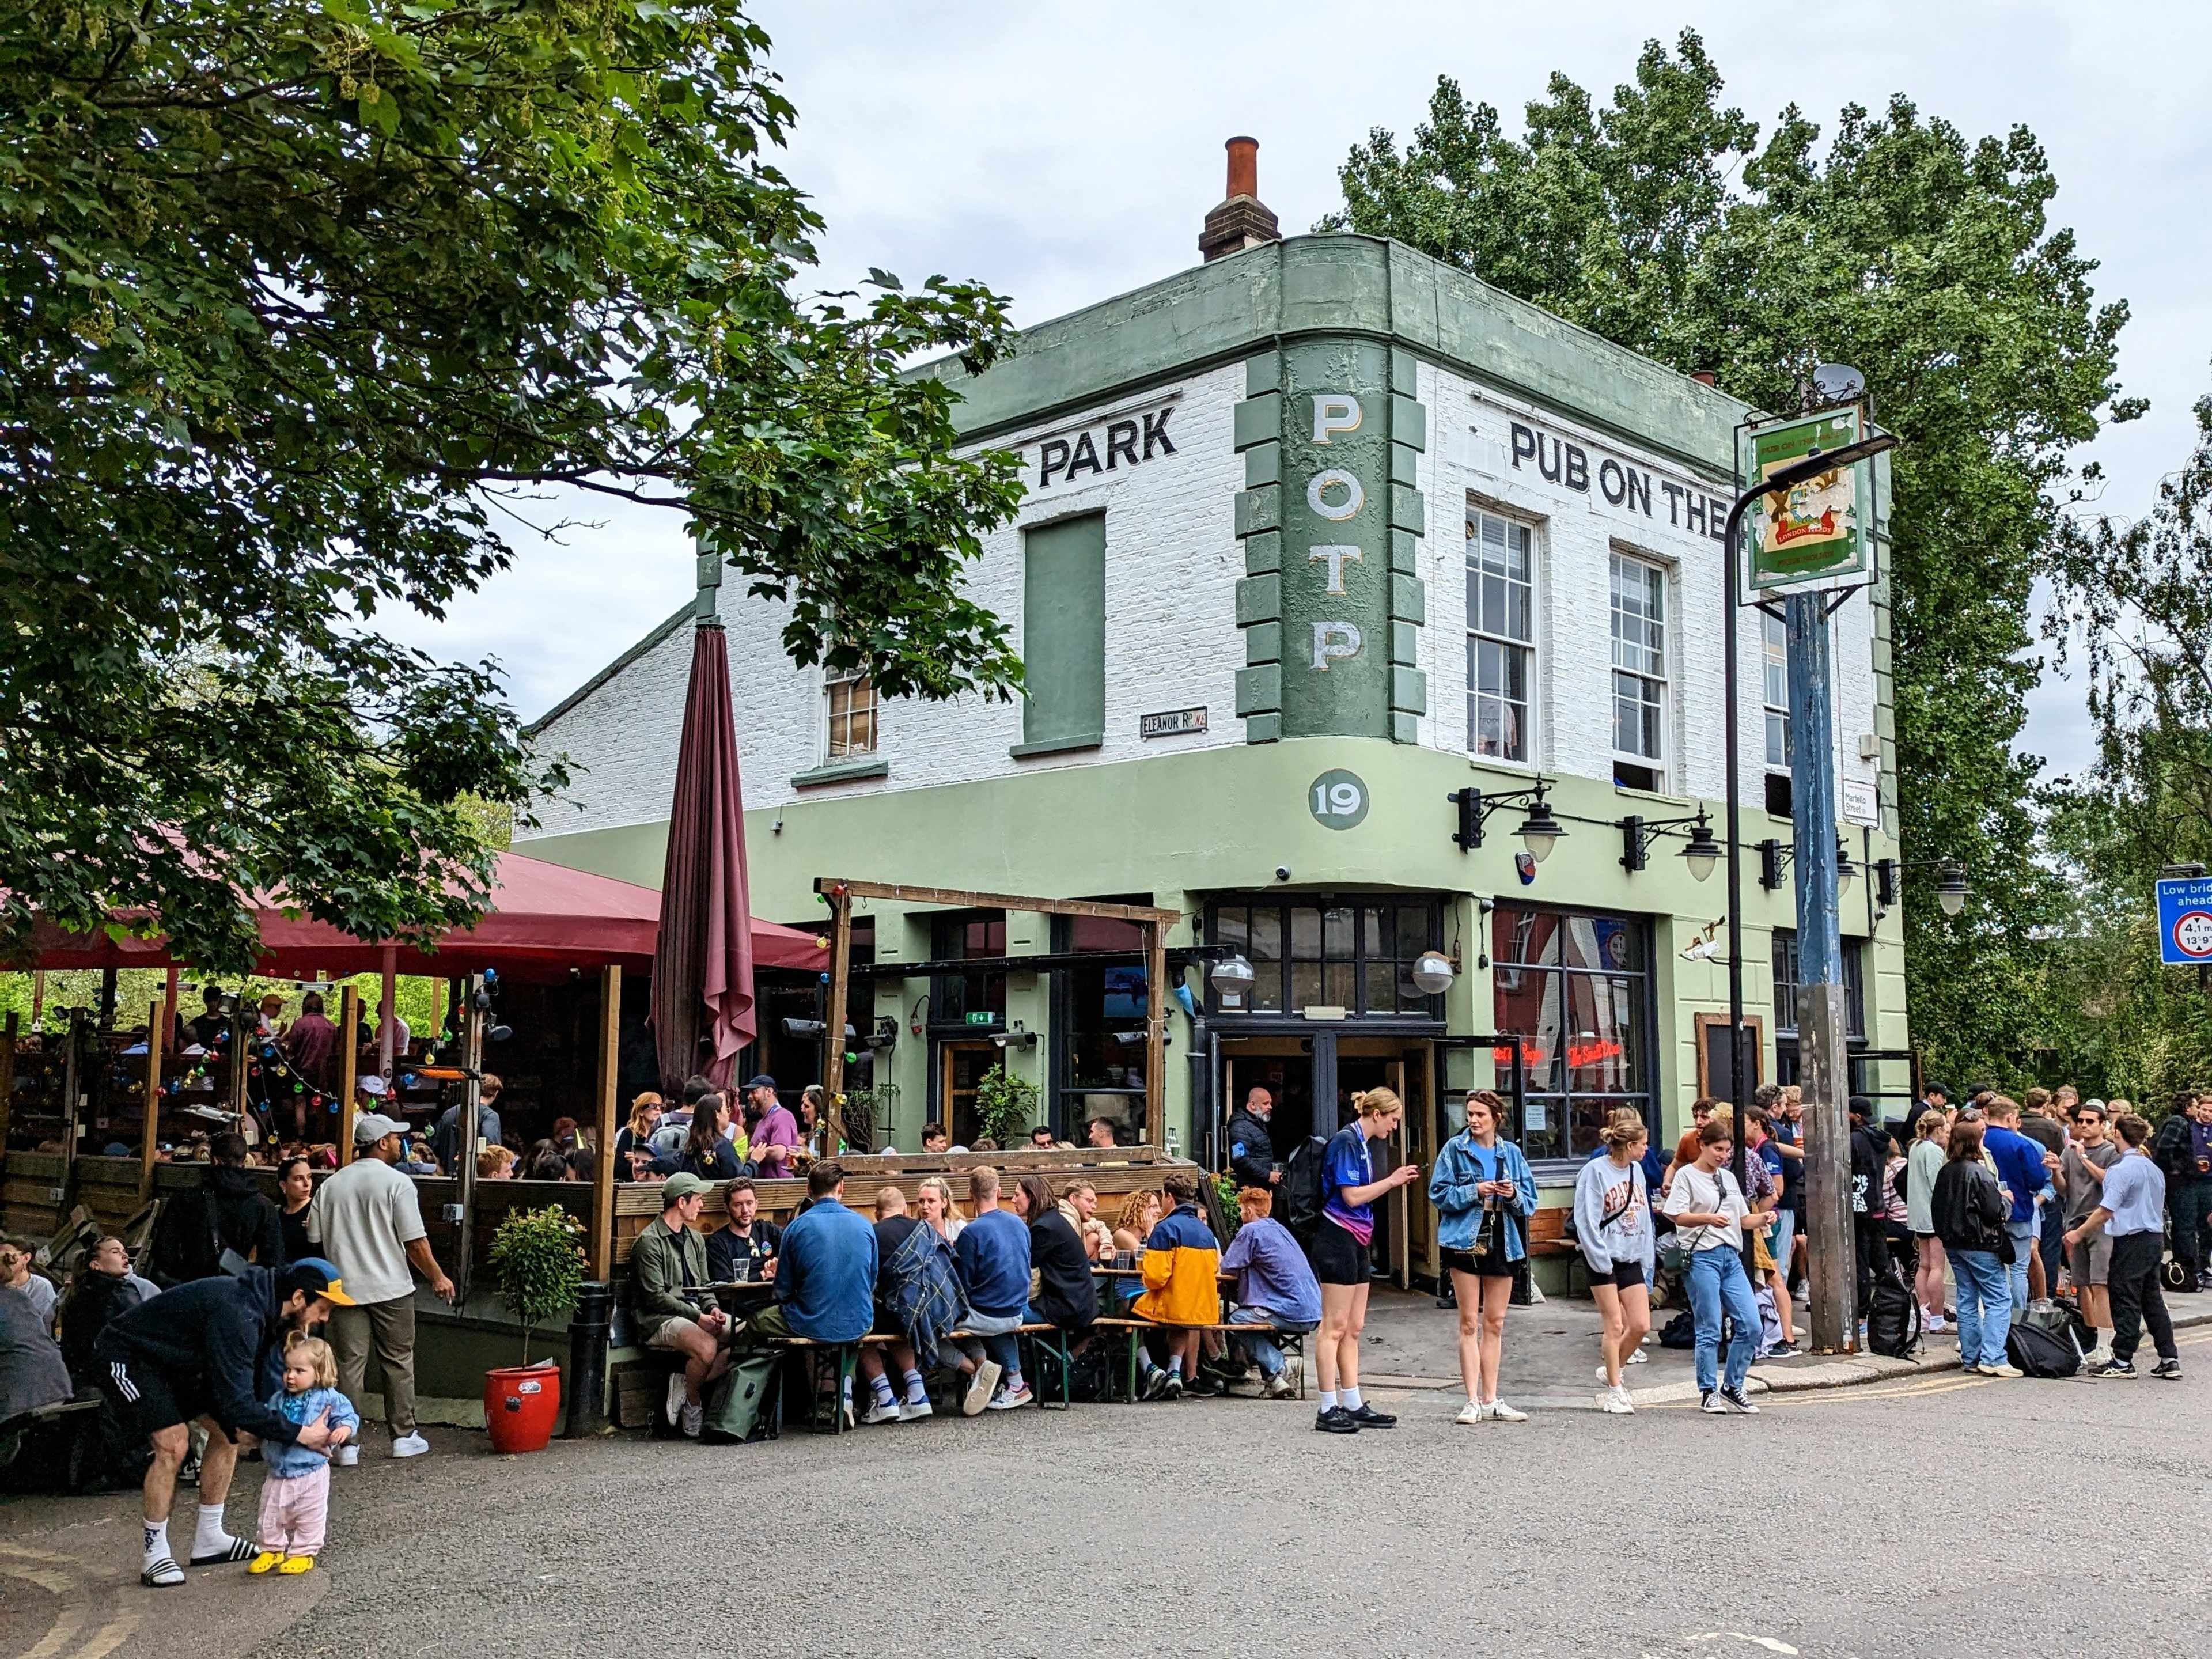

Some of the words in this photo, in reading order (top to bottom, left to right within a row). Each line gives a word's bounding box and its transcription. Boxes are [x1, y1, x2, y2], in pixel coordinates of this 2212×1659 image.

[1039, 407, 1177, 488] PARK
[1510, 421, 1590, 494] PUB
[1599, 459, 1653, 518] ON
[1661, 479, 1727, 544] THE
[1779, 527, 1806, 543] LONDON
[1143, 715, 1179, 733] ELEANOR
[1315, 783, 1361, 815] 19
[1845, 793, 1866, 804] Martello
[1846, 802, 1861, 813] Street
[2163, 885, 2186, 895] Low
[2177, 896, 2212, 906] ahead
